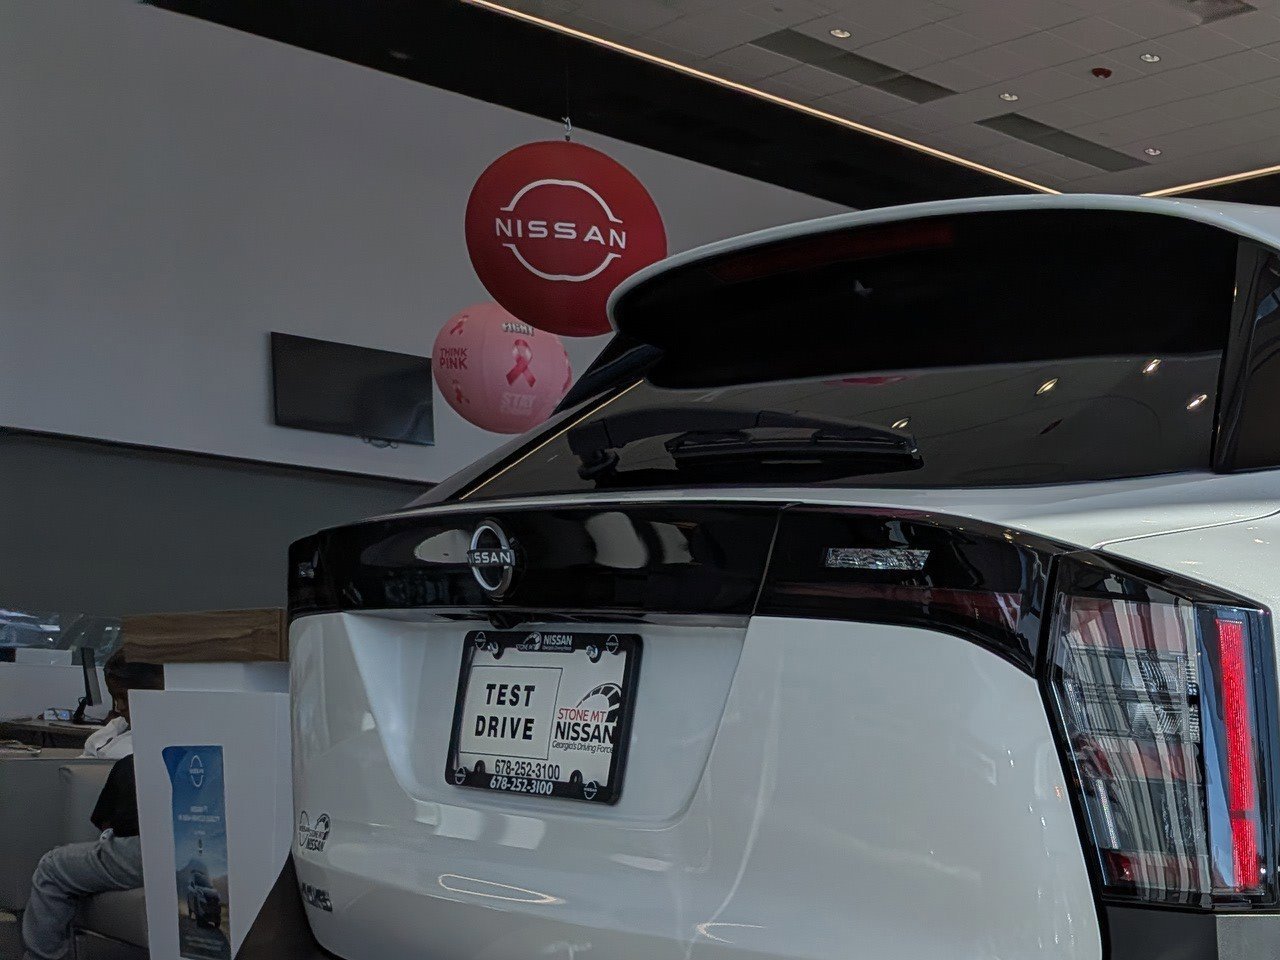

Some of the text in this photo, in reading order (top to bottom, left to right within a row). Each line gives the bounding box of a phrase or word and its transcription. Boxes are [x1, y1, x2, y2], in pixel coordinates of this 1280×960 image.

[495, 217, 626, 250] NISSAN
[440, 347, 469, 357] THINK
[440, 358, 468, 370] PINK
[466, 550, 511, 564] NISSAN
[543, 634, 573, 646] NISSAN
[486, 683, 536, 708] TEST
[557, 707, 607, 724] STONE MT
[475, 715, 535, 741] DRIVE
[554, 720, 616, 744] NISSAN
[494, 759, 560, 781] 678-252-3100
[489, 775, 554, 795] 678-252-3100
